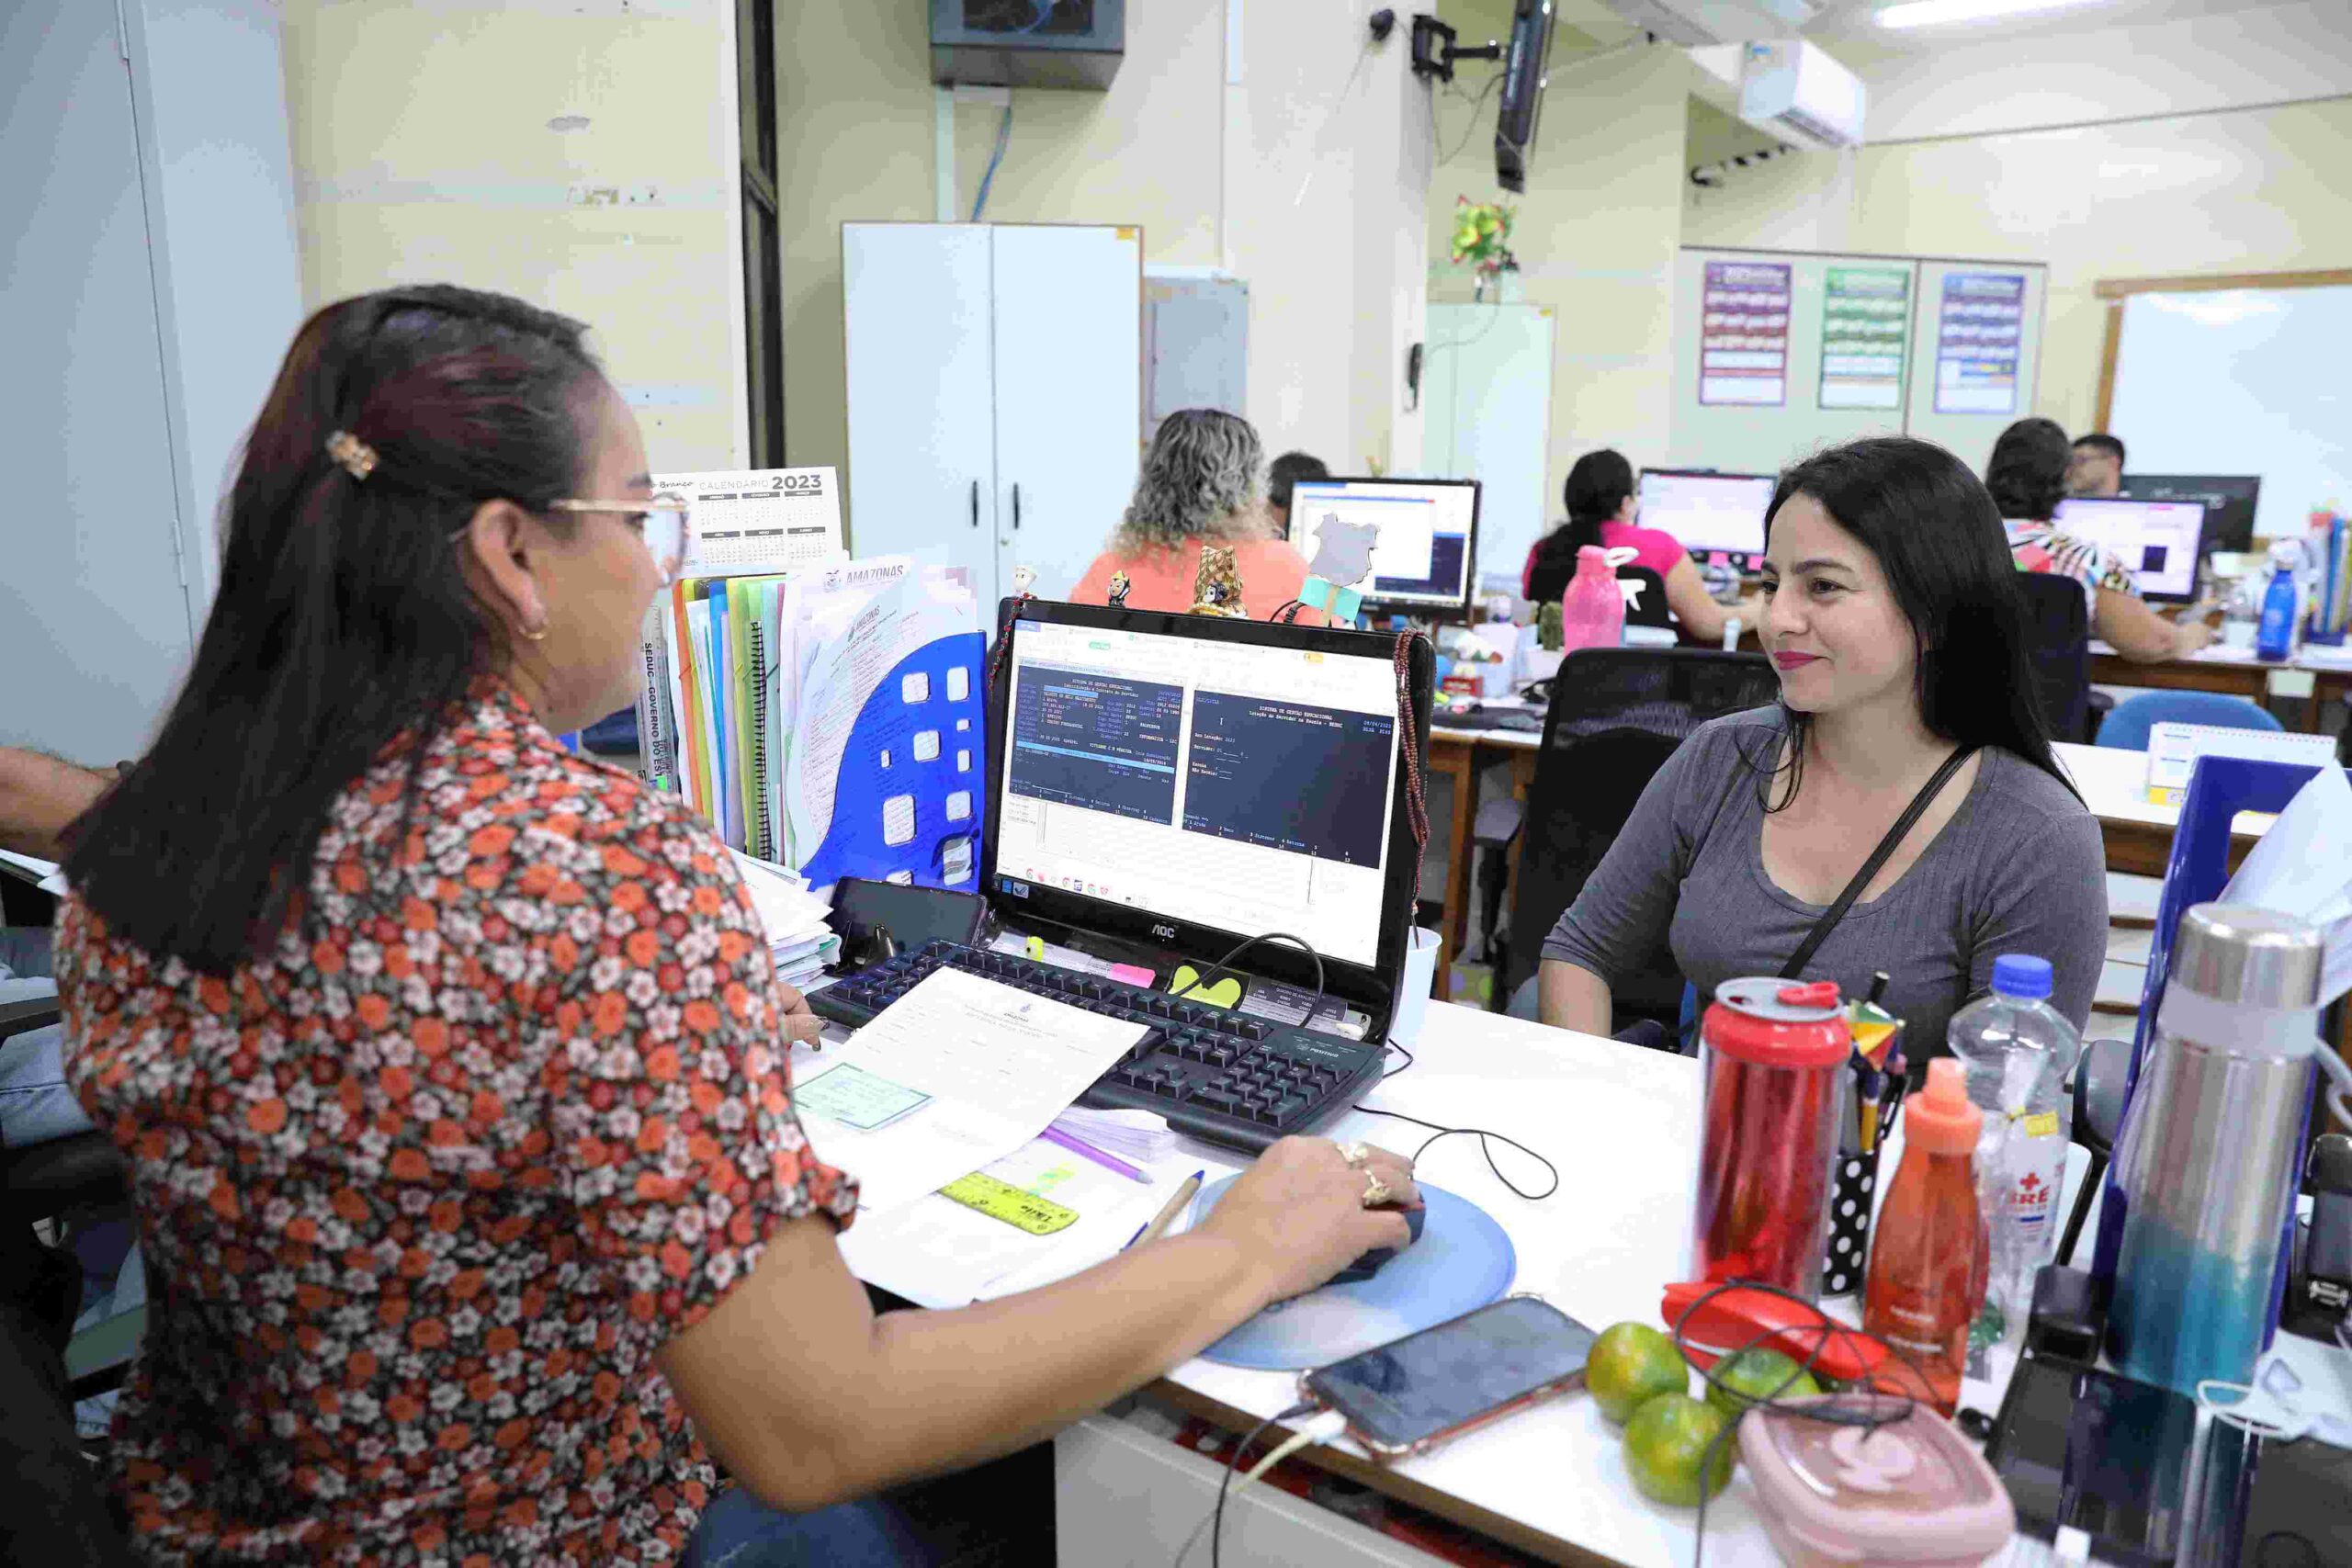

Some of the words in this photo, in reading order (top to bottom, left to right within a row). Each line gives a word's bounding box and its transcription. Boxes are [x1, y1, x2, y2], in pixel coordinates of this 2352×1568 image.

[772, 473, 822, 490] 2023
[846, 565, 904, 583] AMAZONAS
[855, 604, 881, 631] AMAZONAS
[645, 642, 655, 678] SEDUC
[649, 686, 660, 739] GOVERNO
[653, 740, 662, 755] DO
[1151, 924, 1175, 938] AOC
[1310, 1047, 1340, 1058] POSITIVO
